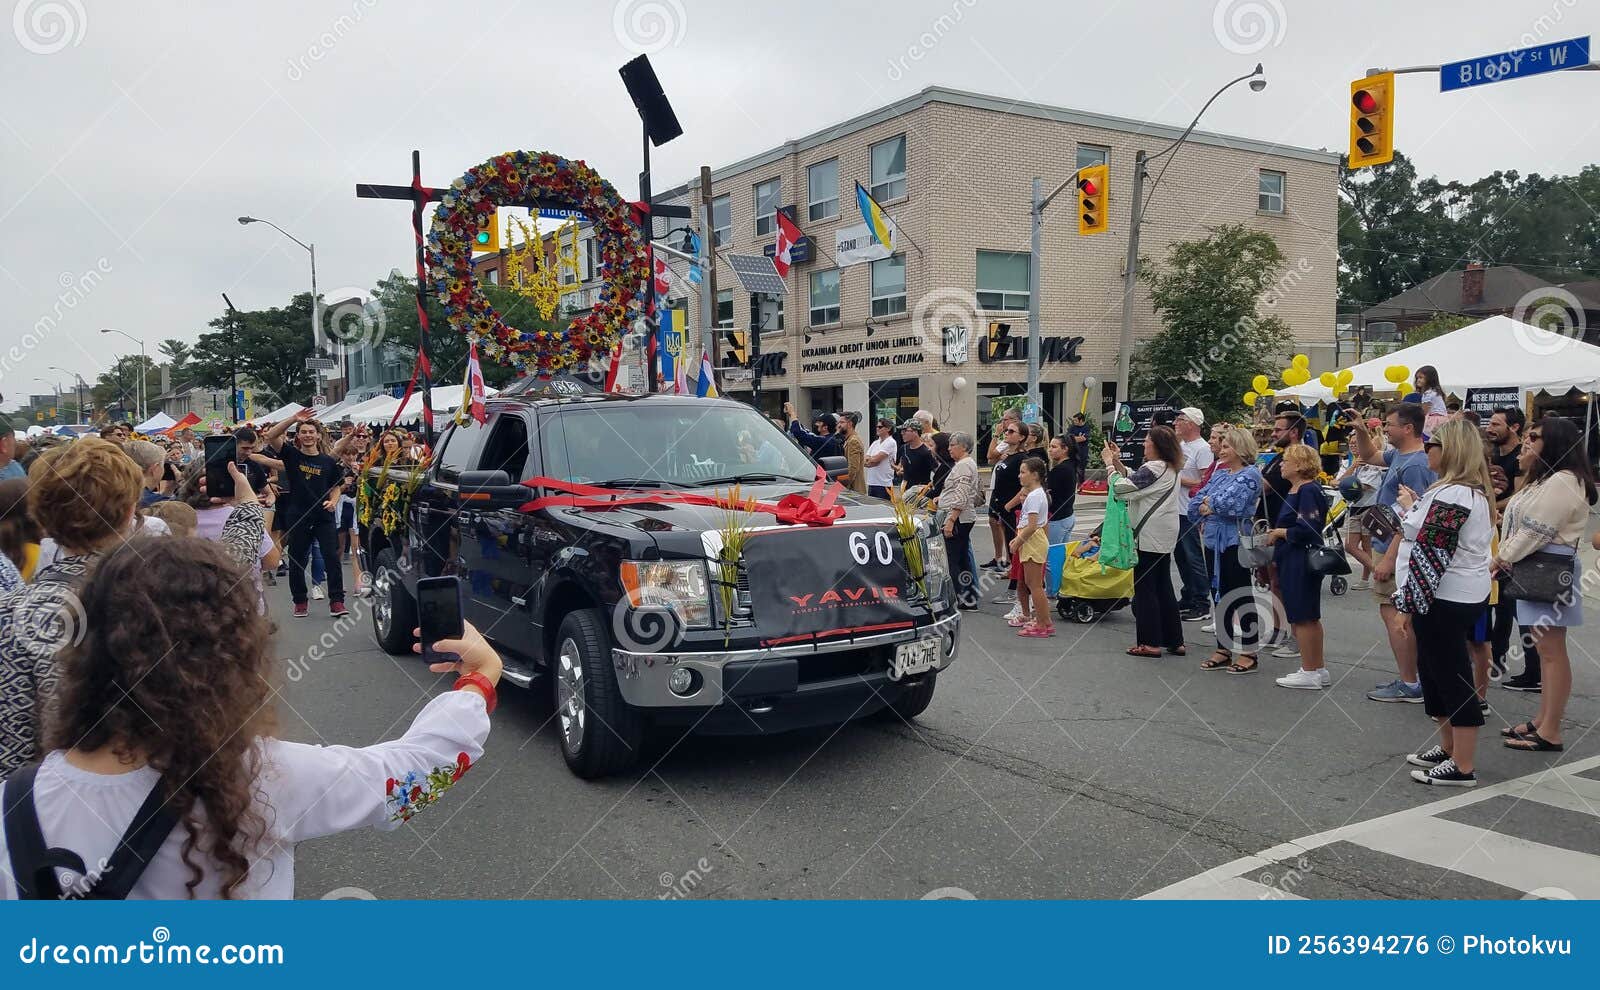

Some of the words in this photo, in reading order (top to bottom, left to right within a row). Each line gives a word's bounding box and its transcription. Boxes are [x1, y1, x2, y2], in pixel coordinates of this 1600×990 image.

[1459, 57, 1522, 83] Bloor
[1530, 51, 1542, 61] St
[1549, 45, 1567, 66] W
[801, 346, 837, 358] UKRAINIAN
[839, 342, 864, 354] CREDIT
[865, 340, 889, 351] UNION
[892, 336, 923, 348] LIMITED
[845, 356, 890, 370] КРЕДИТОВА
[892, 353, 924, 365] СПІЛКА
[849, 531, 893, 565] 60
[788, 586, 899, 607] YAVIR
